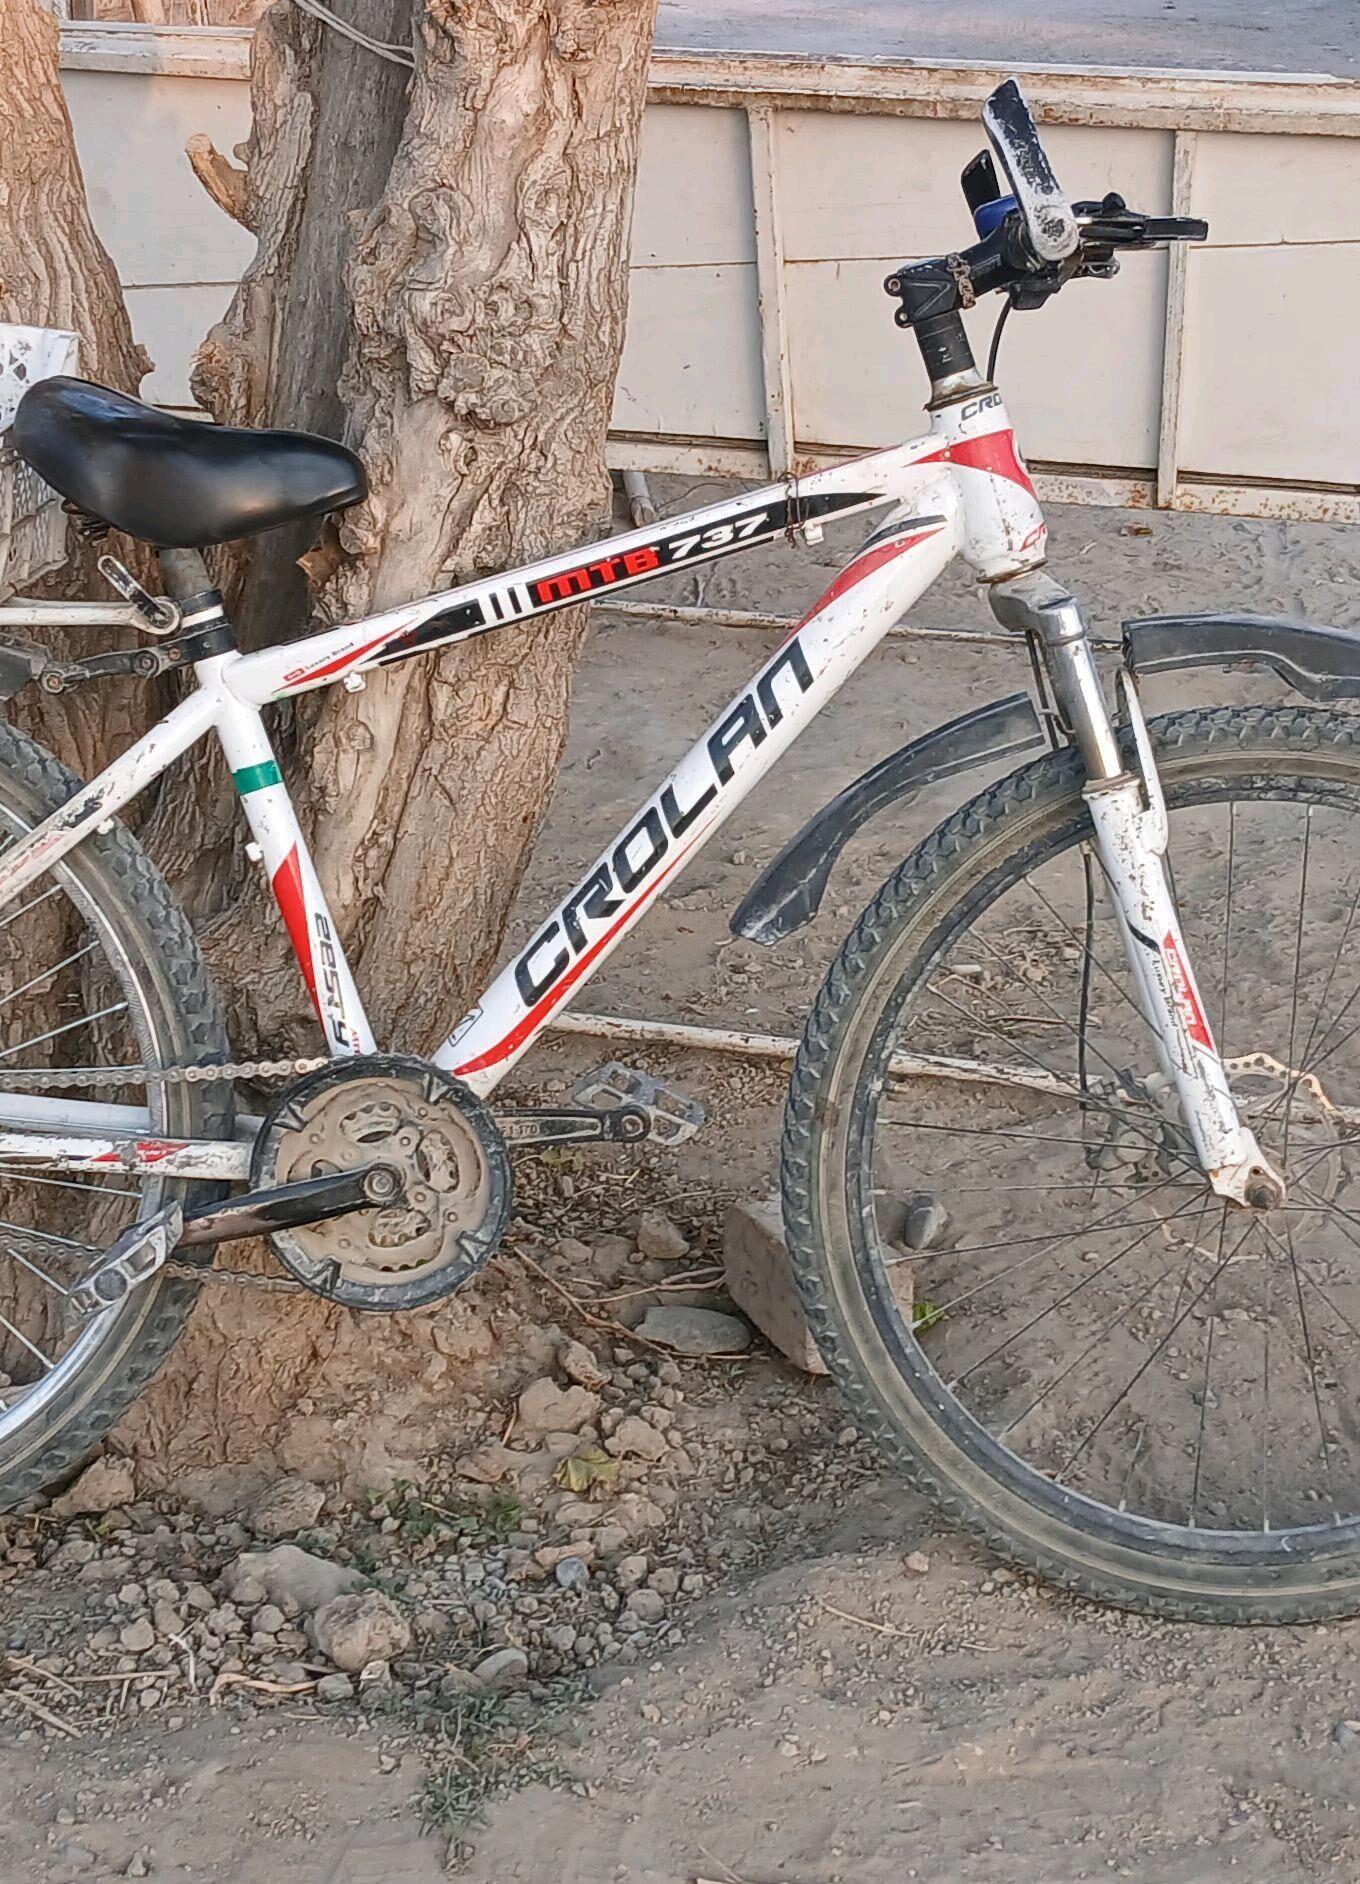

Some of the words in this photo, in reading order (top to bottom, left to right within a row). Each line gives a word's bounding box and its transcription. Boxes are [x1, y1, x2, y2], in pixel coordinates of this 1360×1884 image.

[537, 545, 660, 603] MTB
[668, 512, 768, 560] 737
[514, 636, 815, 1008] CROLAN
